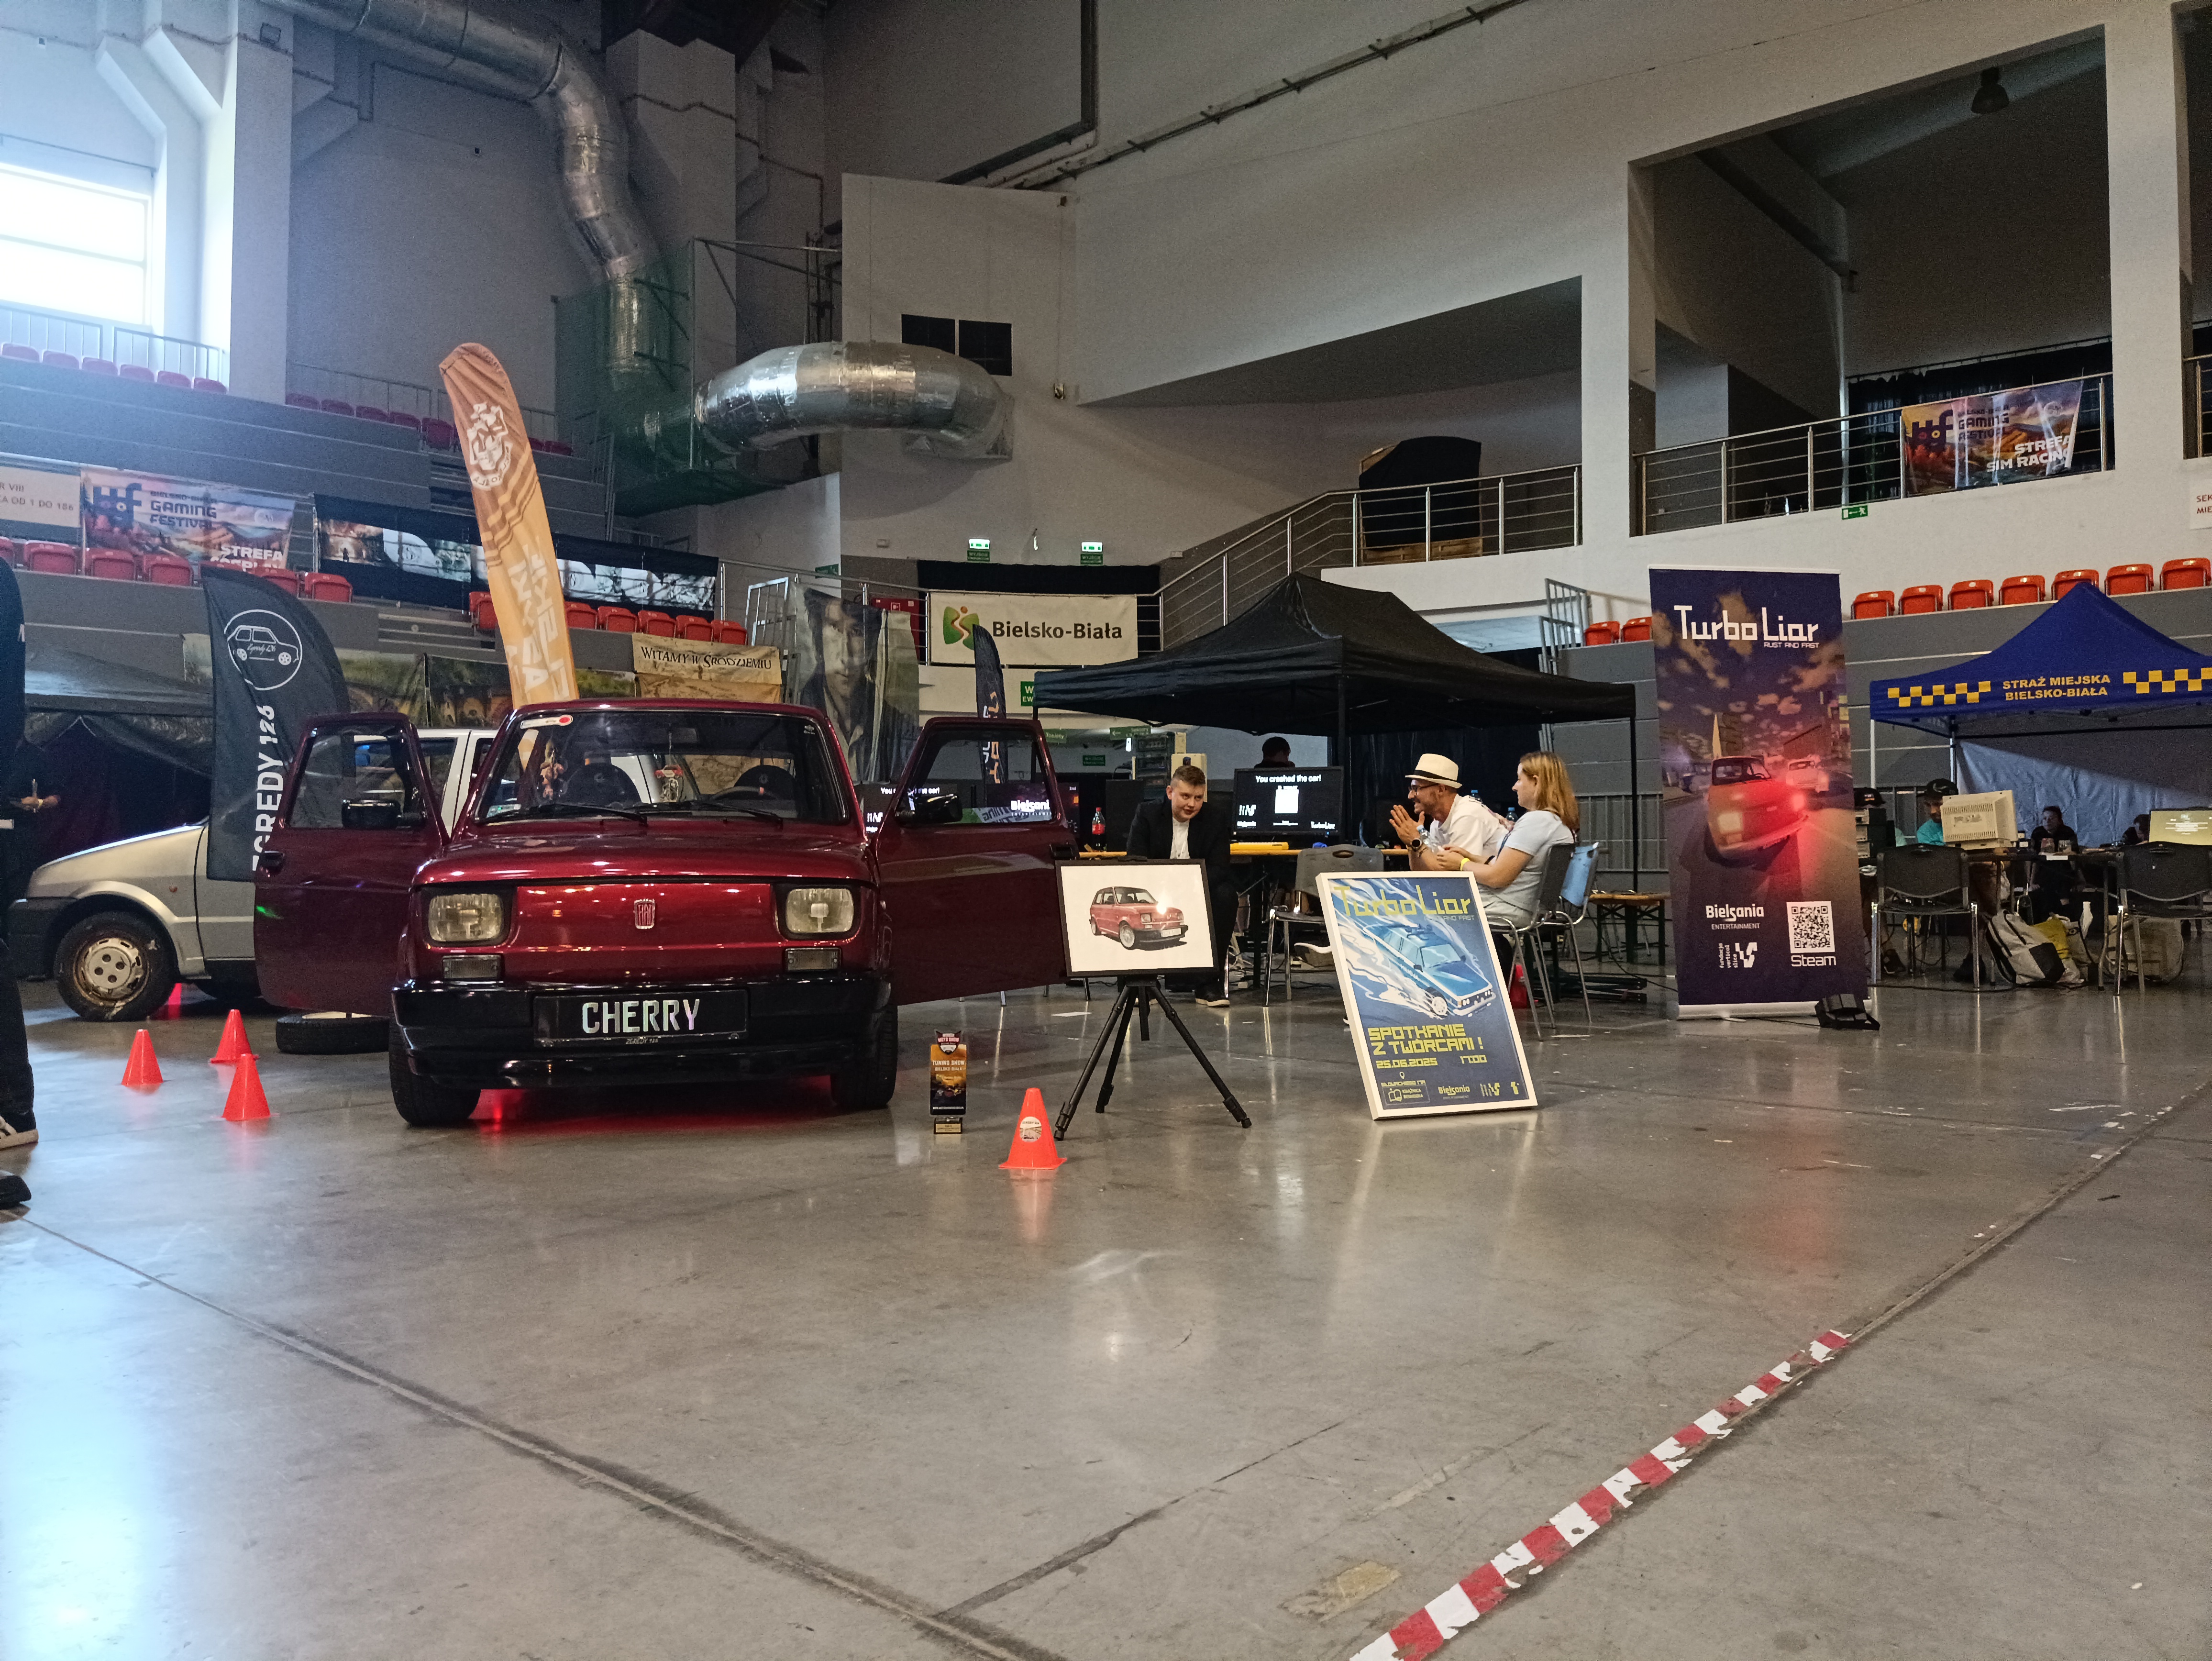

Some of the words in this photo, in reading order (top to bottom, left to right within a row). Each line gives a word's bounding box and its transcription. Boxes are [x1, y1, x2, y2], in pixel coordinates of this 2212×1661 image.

[1986, 457, 2013, 472] SIM
[11, 496, 25, 505] OD
[39, 500, 53, 509] DO
[150, 500, 217, 519] GAMING
[221, 544, 283, 562] STREFA
[993, 621, 1122, 639] Bielsko-Biała
[641, 646, 689, 664] WITAMY
[2003, 676, 2046, 689] STRAŻ
[2050, 675, 2111, 686] MIEJSKA
[2005, 687, 2108, 701] BIELSKO-BIAŁA
[256, 705, 277, 745] 126
[1706, 904, 1764, 922] Bielsania
[1791, 955, 1836, 967] Steam
[582, 999, 700, 1034] CHERRY
[1368, 1023, 1466, 1041] SPOTKANIE
[1371, 1042, 1386, 1055] Z
[1388, 1037, 1475, 1054] TWÓRCAMI
[1375, 1057, 1438, 1069] 25.06.2025
[1460, 1054, 1487, 1064] 17:00
